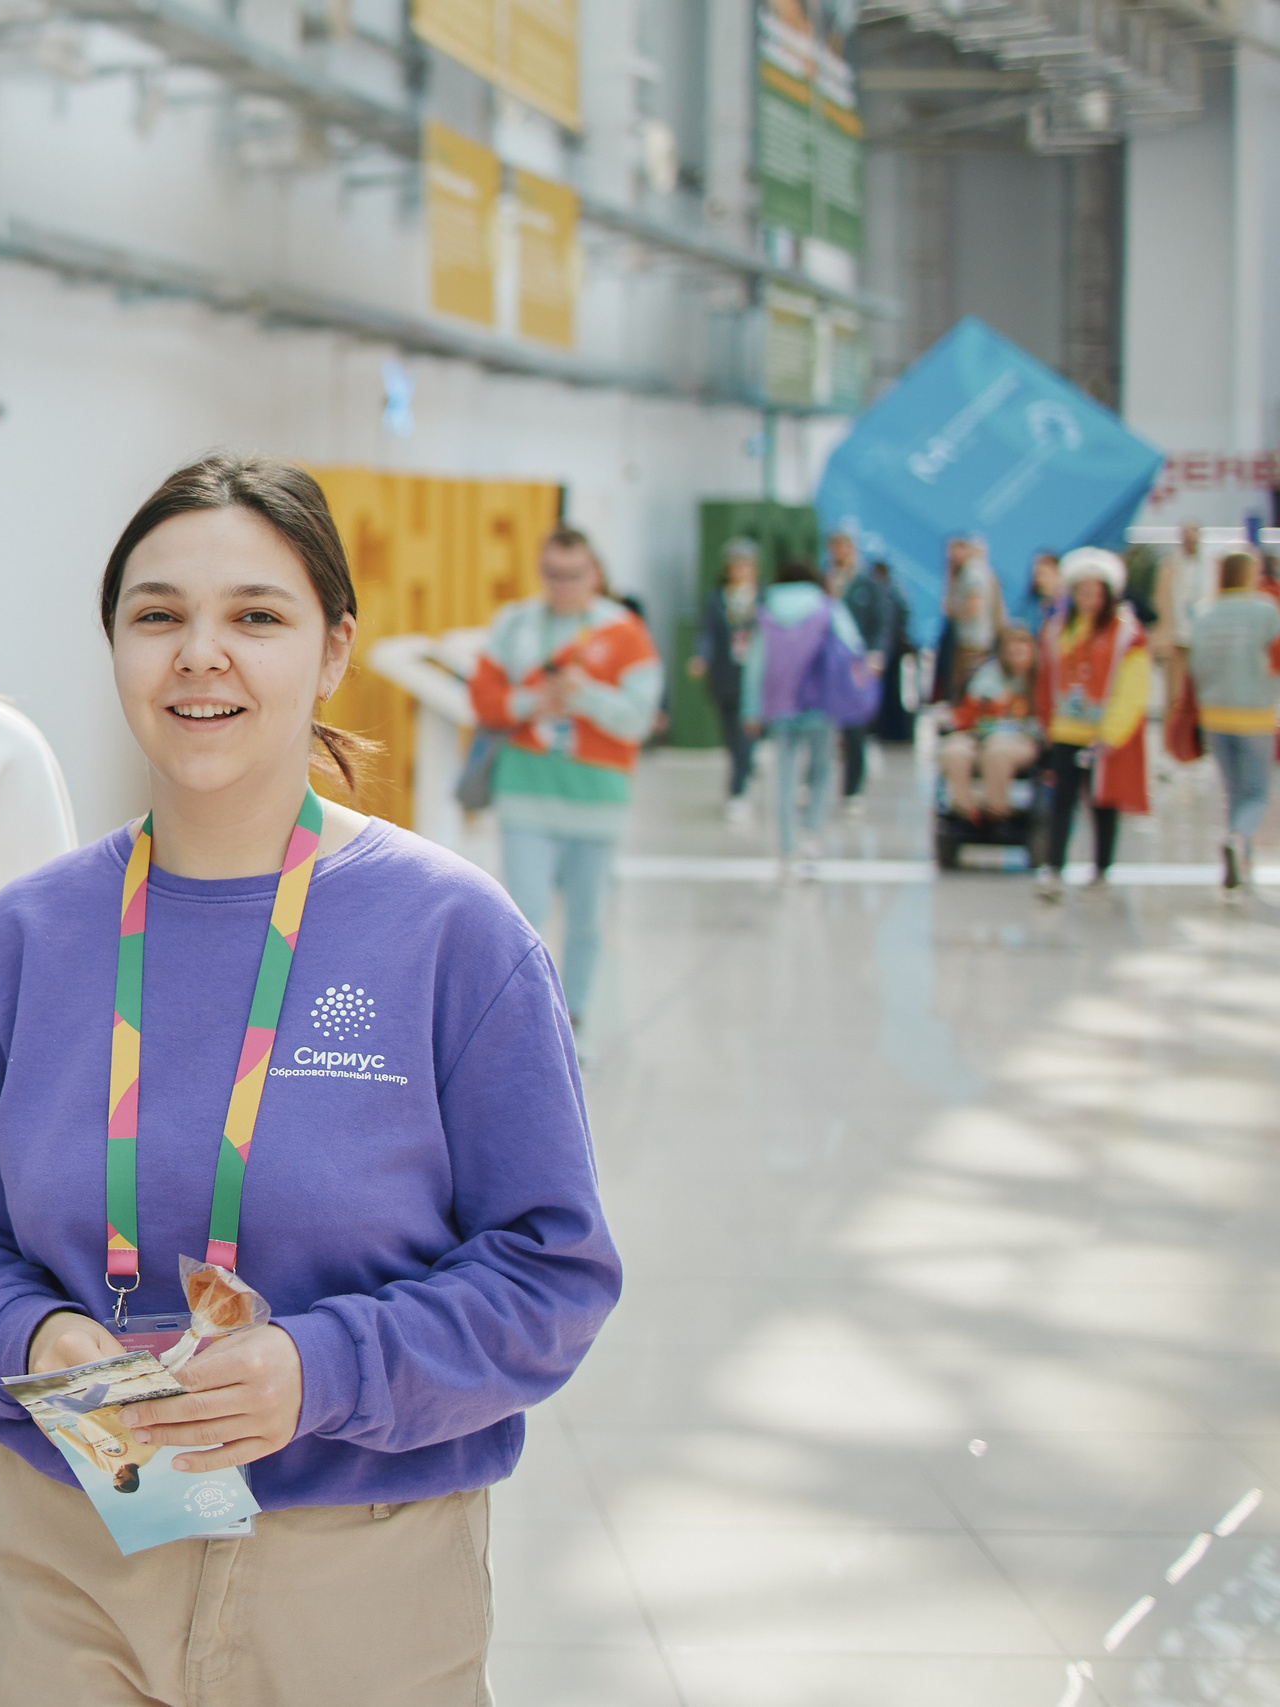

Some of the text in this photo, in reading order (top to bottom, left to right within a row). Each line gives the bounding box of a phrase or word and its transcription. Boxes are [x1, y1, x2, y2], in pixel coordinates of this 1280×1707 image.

[293, 1046, 386, 1072] Сириус
[269, 1067, 408, 1086] Образовательный центр
[199, 1501, 235, 1518] BEREGI
